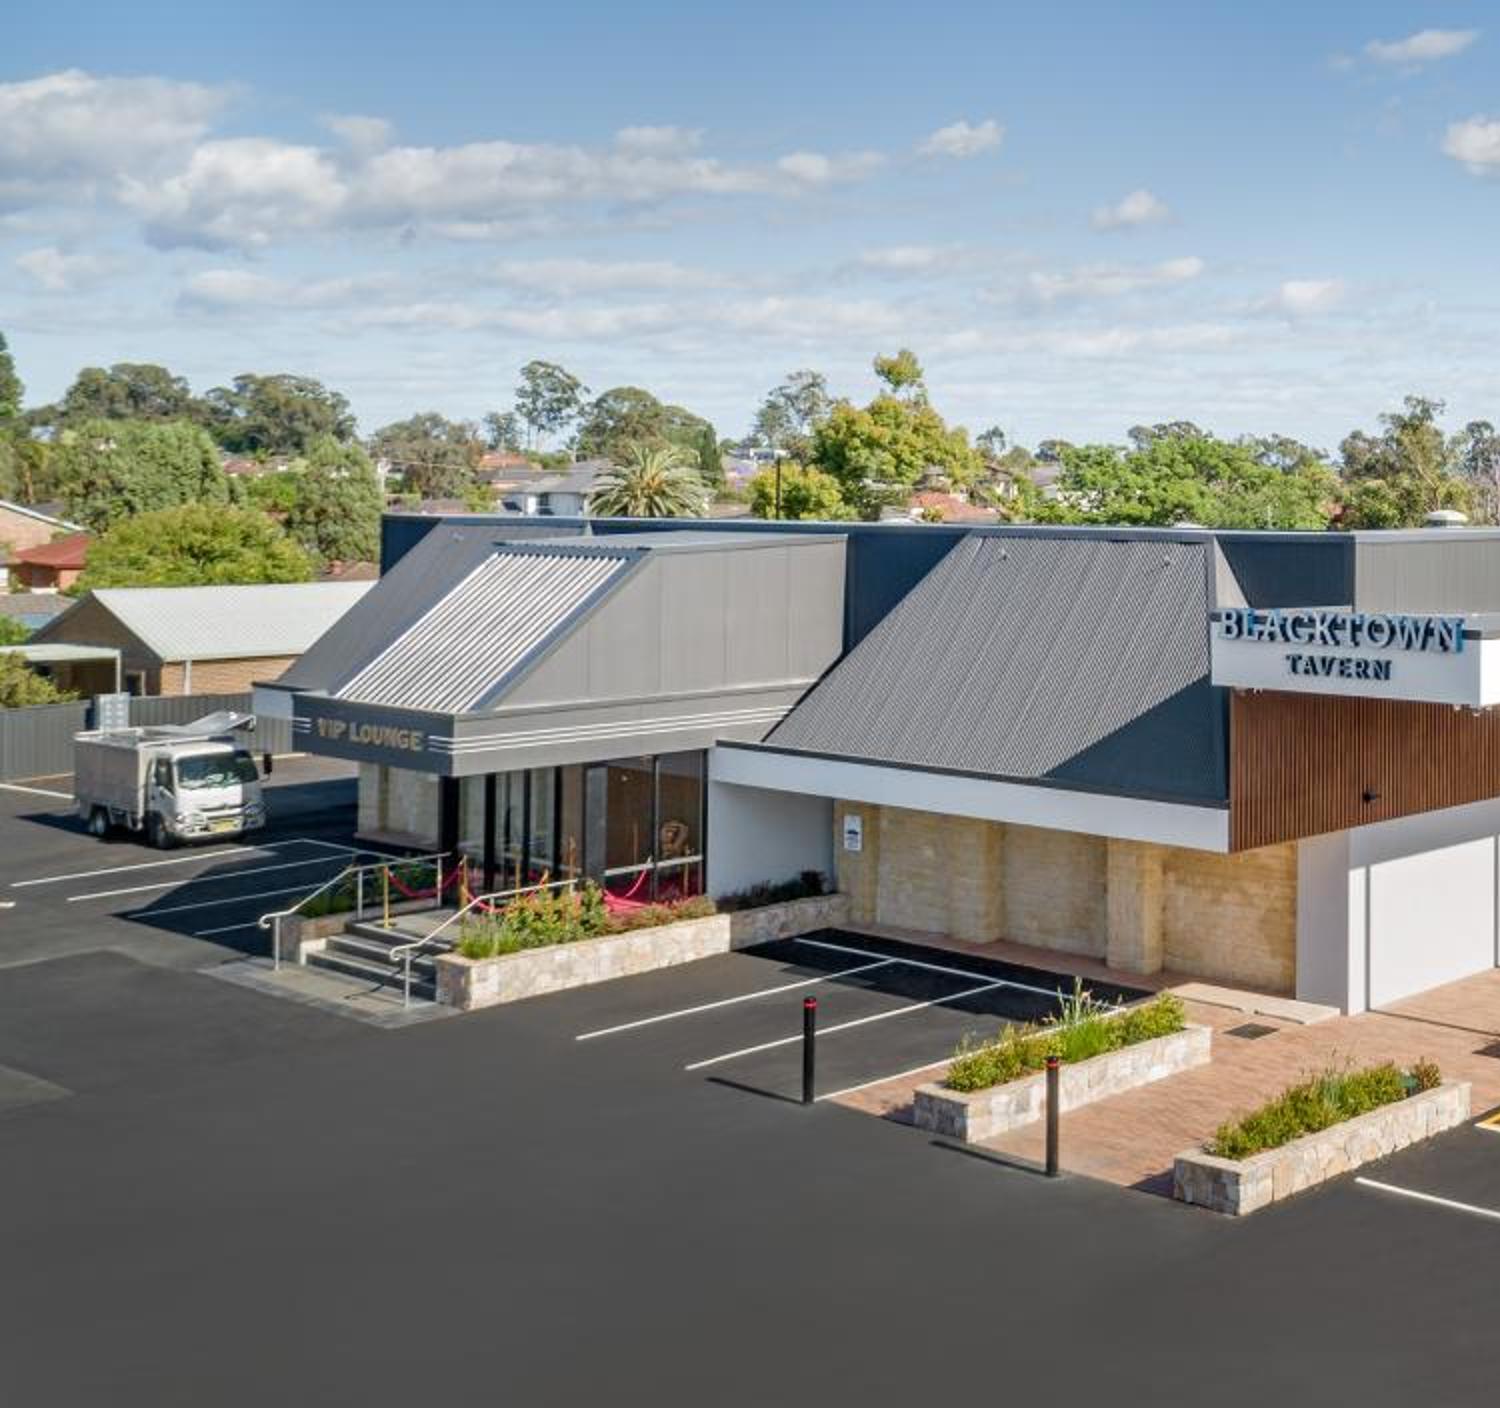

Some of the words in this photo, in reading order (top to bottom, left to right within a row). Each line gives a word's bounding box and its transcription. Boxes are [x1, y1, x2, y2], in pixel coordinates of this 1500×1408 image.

[1219, 608, 1465, 654] BLACKTOWN
[1286, 653, 1392, 681] TAVERN
[317, 717, 347, 740] VIP
[350, 722, 424, 751] LOUNGE
